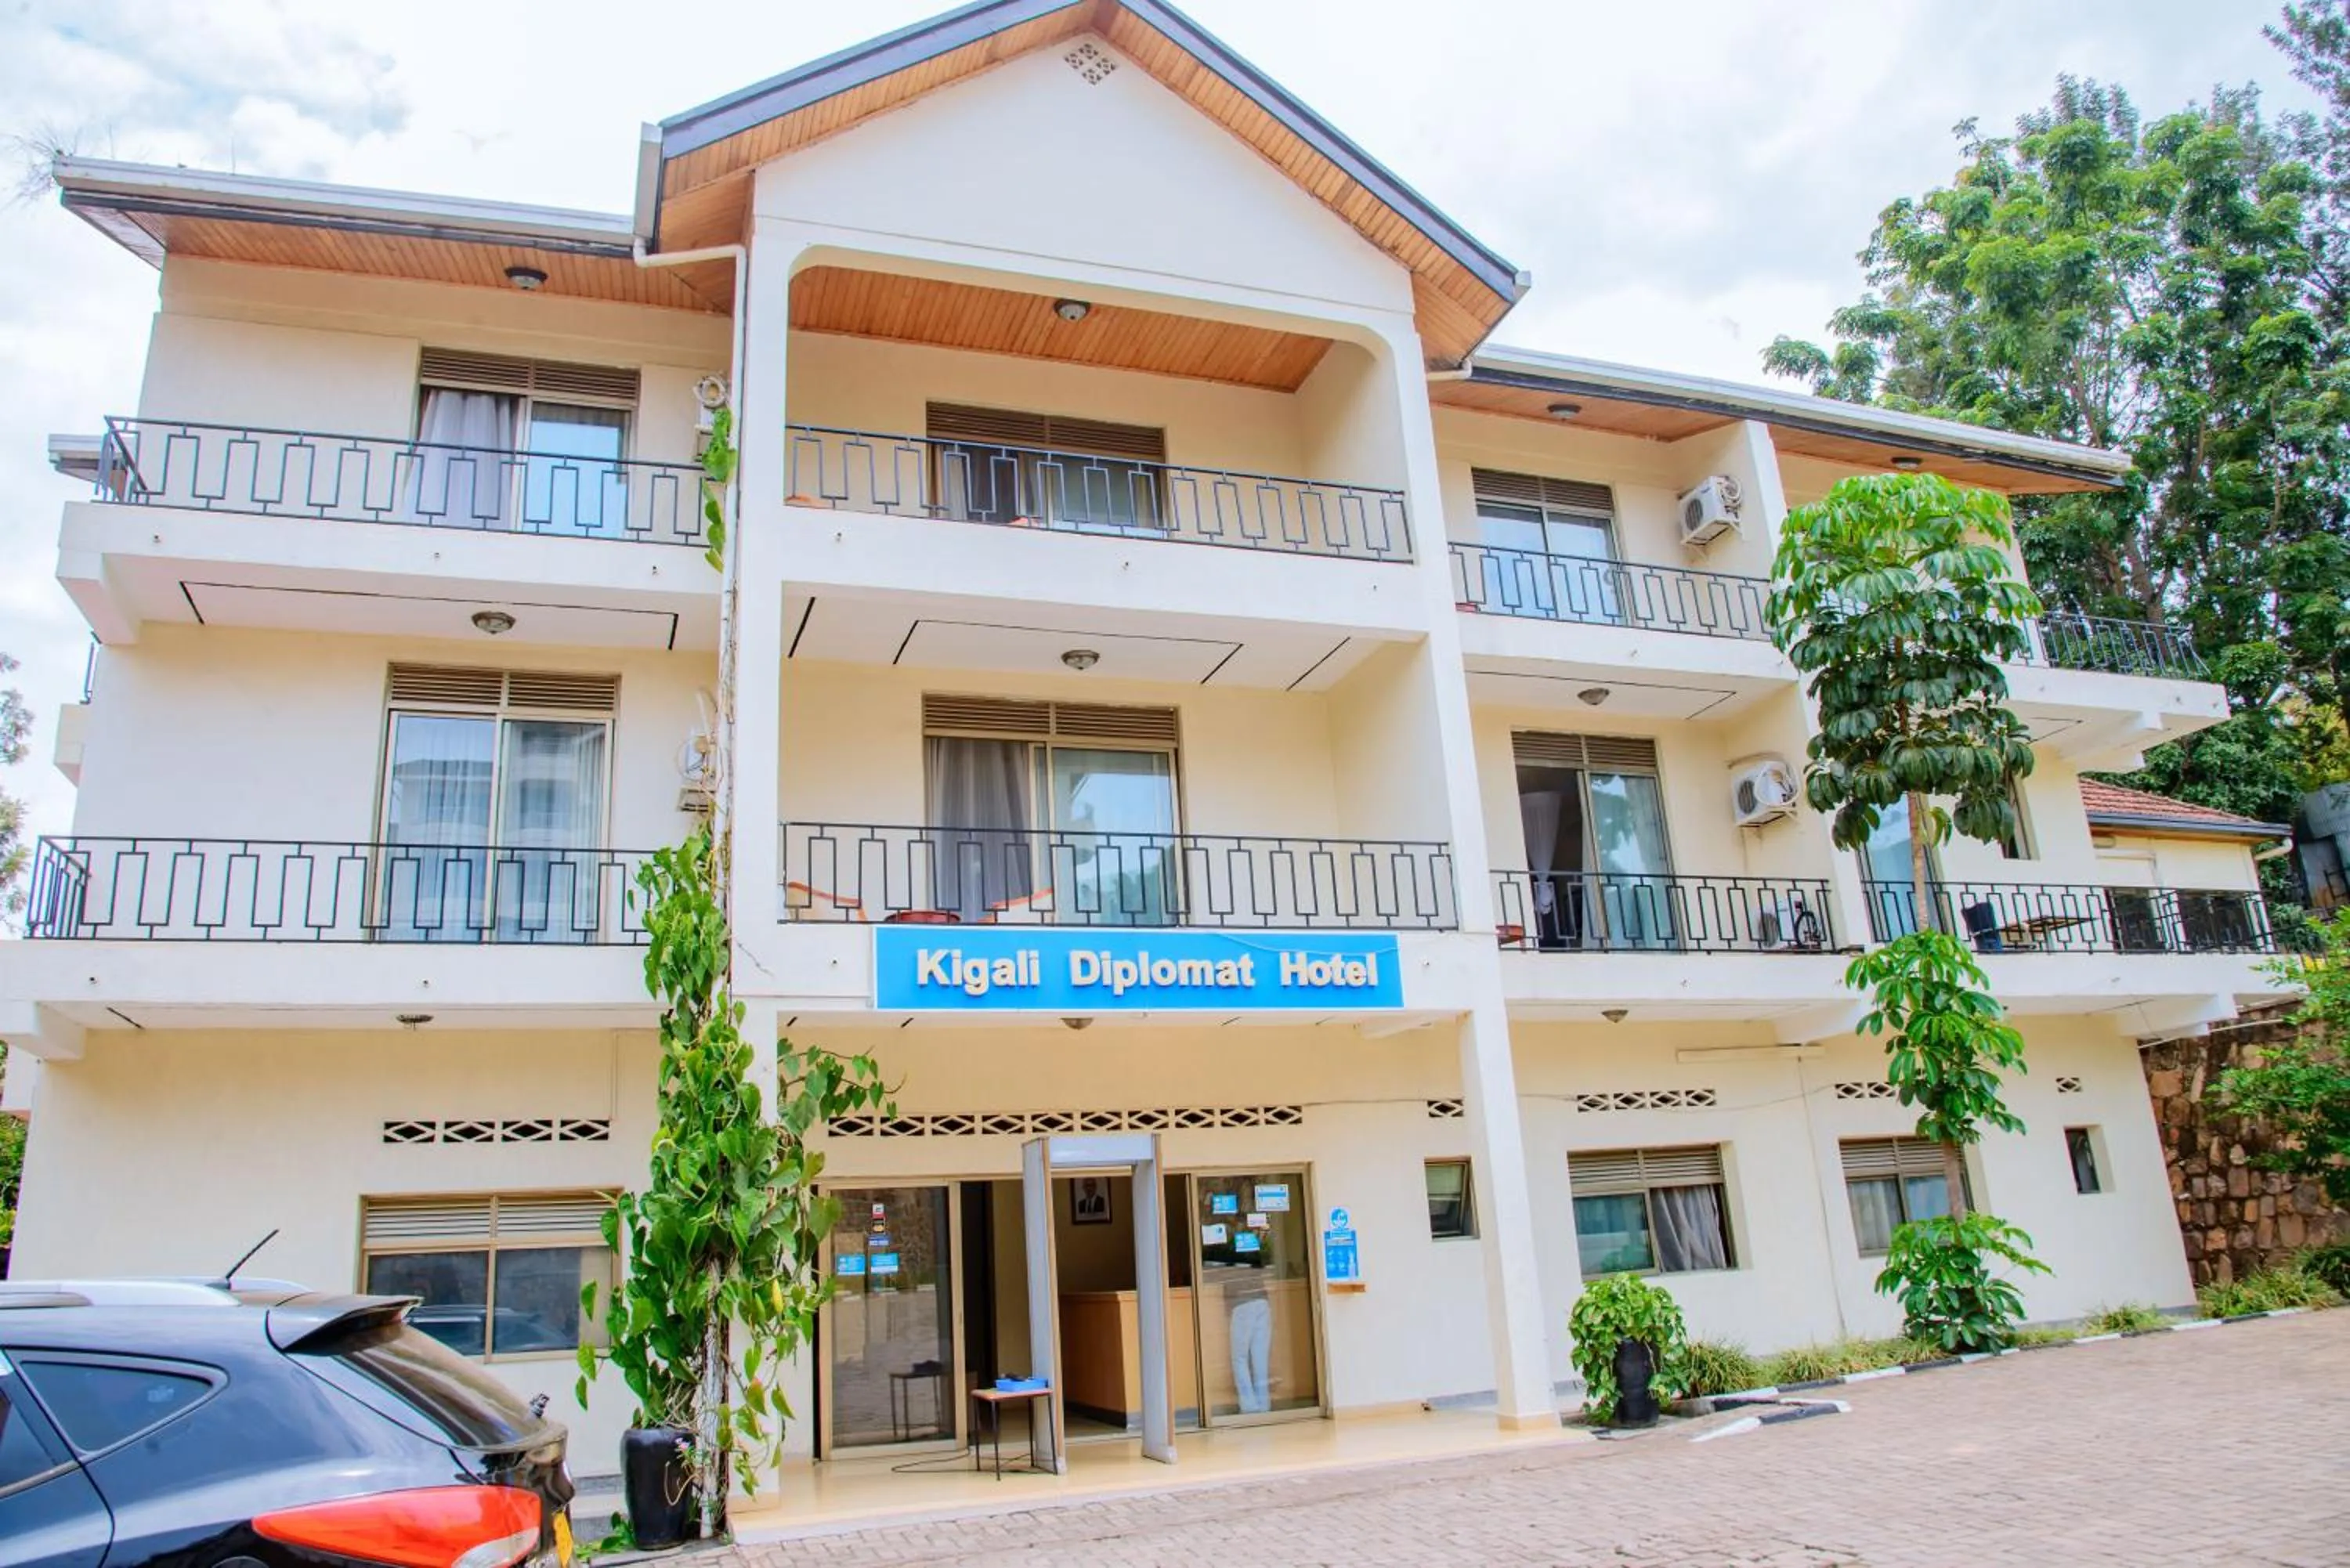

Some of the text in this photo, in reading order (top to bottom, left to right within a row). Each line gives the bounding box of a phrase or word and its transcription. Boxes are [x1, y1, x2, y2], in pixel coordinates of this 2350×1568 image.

[916, 948, 1379, 995] Kigali Diplomat Hotel
